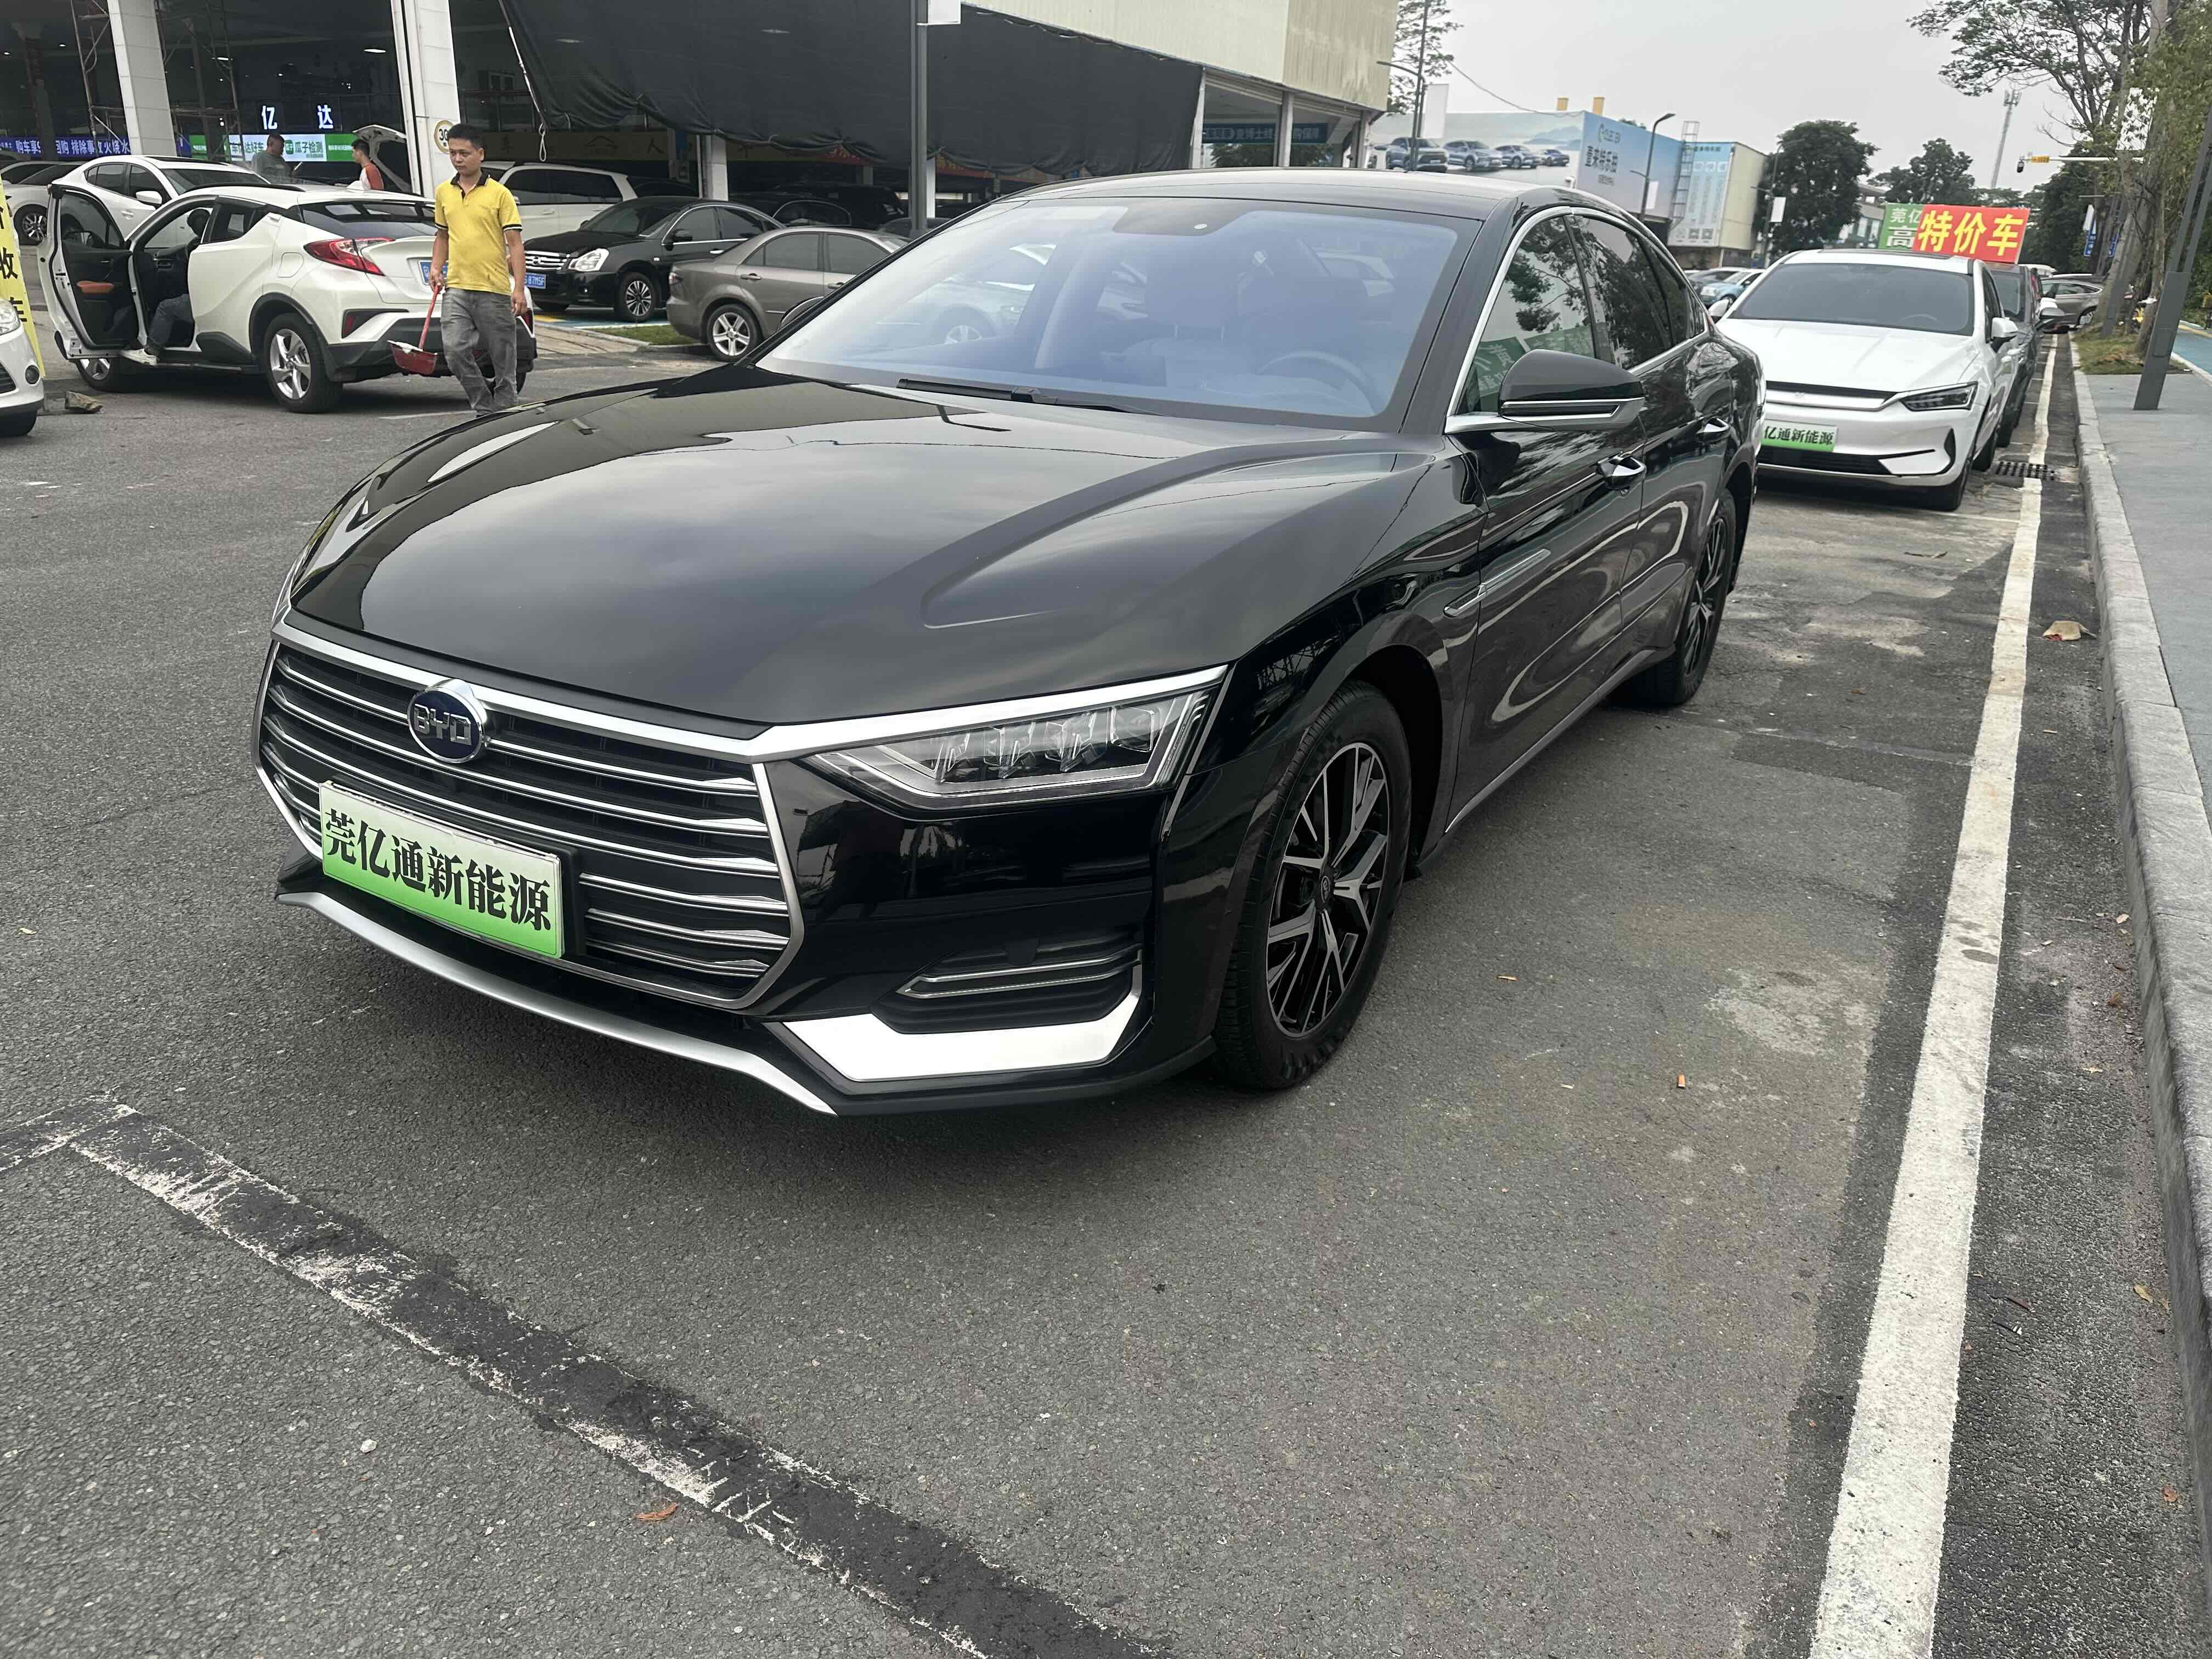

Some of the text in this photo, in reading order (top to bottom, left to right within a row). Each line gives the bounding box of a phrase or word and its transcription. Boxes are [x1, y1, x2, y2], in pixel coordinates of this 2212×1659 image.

[1886, 225, 1918, 249] 高
[1917, 210, 2024, 256] 特价车
[413, 703, 472, 746] BYD
[324, 808, 552, 932] 莞亿通新能源
